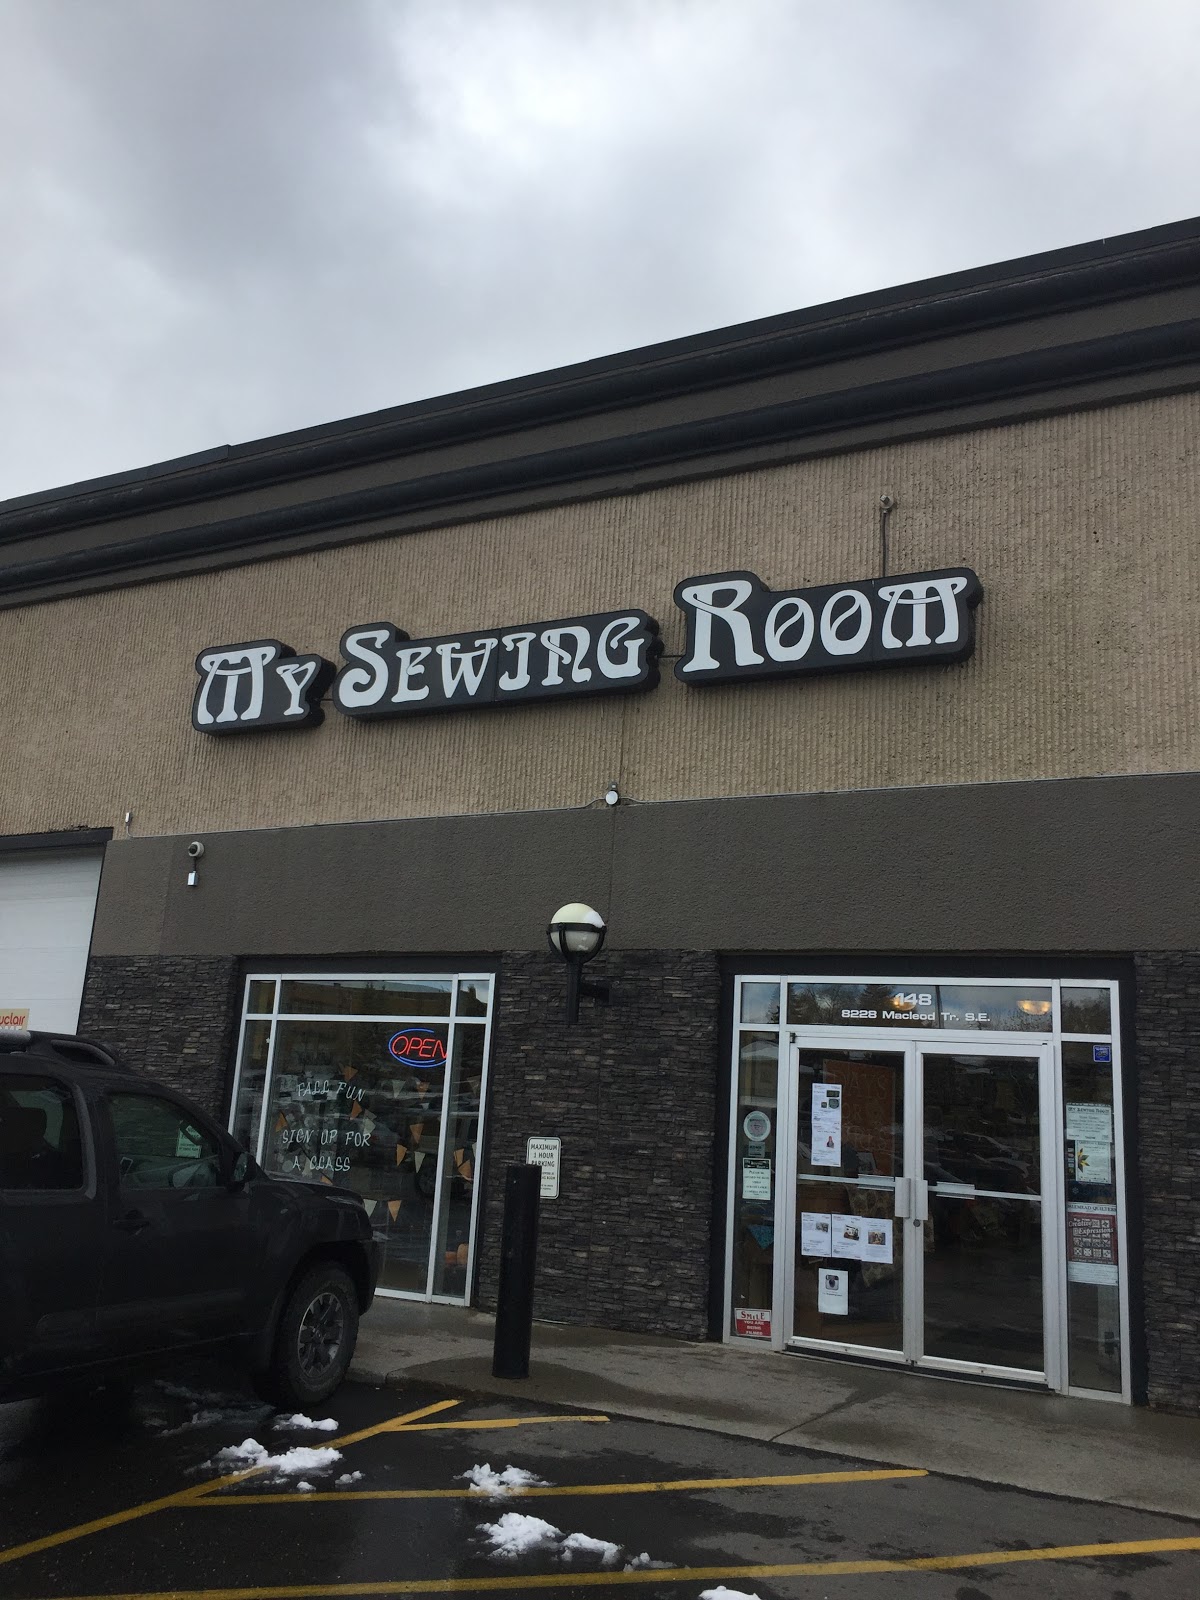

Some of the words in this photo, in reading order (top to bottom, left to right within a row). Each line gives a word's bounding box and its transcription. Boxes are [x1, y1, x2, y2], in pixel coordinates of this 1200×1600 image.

[841, 1009, 878, 1019] 8228
[882, 1010, 936, 1021] Macleod
[940, 1012, 960, 1021] Tr.
[964, 1012, 991, 1022] S.E.
[391, 1035, 448, 1059] OPEN
[297, 1079, 330, 1097] FALL
[336, 1081, 366, 1102] FUN
[282, 1128, 315, 1144] SIGN
[320, 1128, 338, 1145] UP
[345, 1130, 372, 1147] FOR
[292, 1155, 301, 1171] A
[309, 1155, 351, 1172] CLASS
